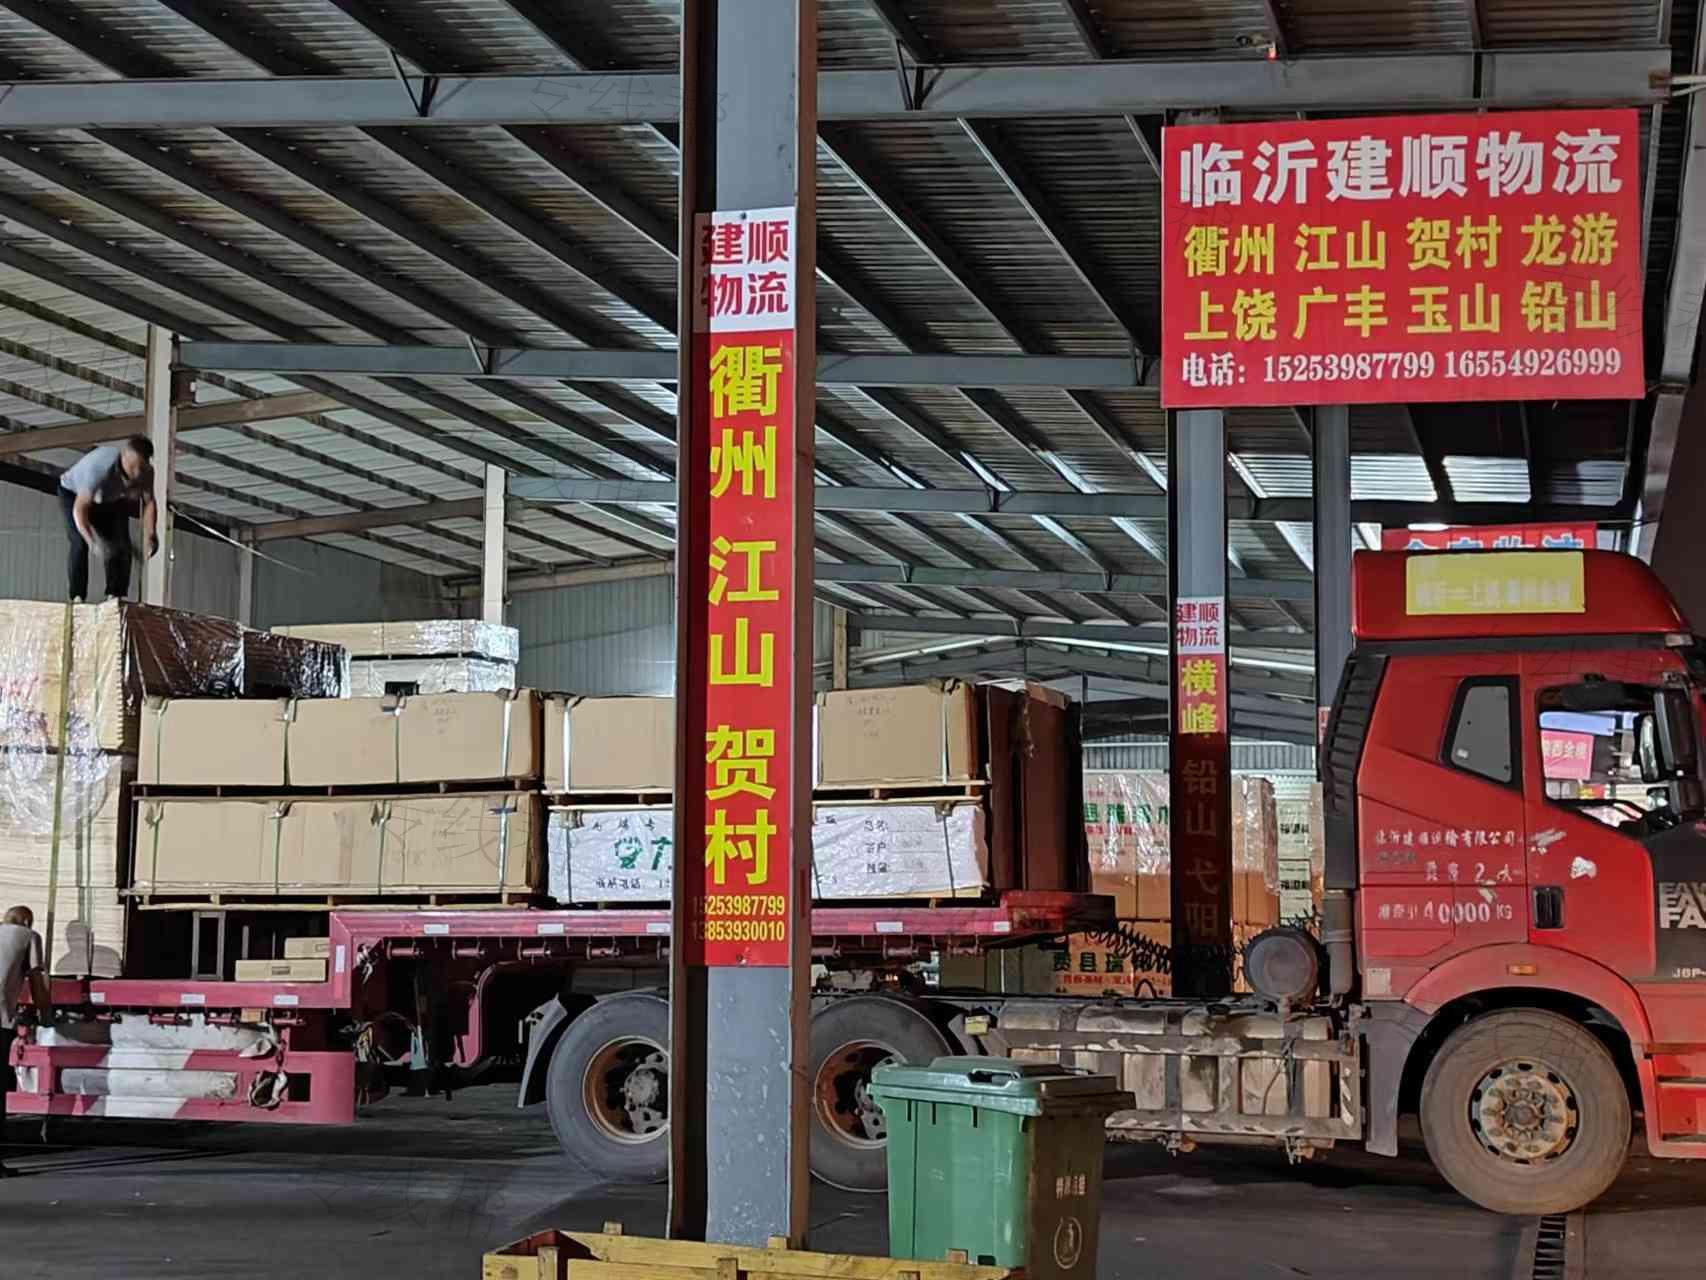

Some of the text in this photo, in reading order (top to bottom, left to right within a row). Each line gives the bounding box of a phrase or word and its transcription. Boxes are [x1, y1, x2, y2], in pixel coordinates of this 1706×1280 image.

[1179, 128, 1623, 208] 临沂建顺物流
[702, 220, 789, 265] 建顺
[1183, 211, 1619, 277] 衢州 江山 贺村 龙游
[701, 271, 789, 318] 物流
[1183, 280, 1618, 342] 上饶 广丰 玉山 铅山
[1263, 352, 1435, 382] 15253987799
[1443, 347, 1622, 378] 16554926999
[704, 345, 783, 885] 衢州 江山 贺村
[1176, 602, 1220, 623] 建顺
[1176, 626, 1220, 647] 物流
[1181, 658, 1219, 937] 横峰 铅山 弋阳
[1423, 901, 1491, 924] 40000
